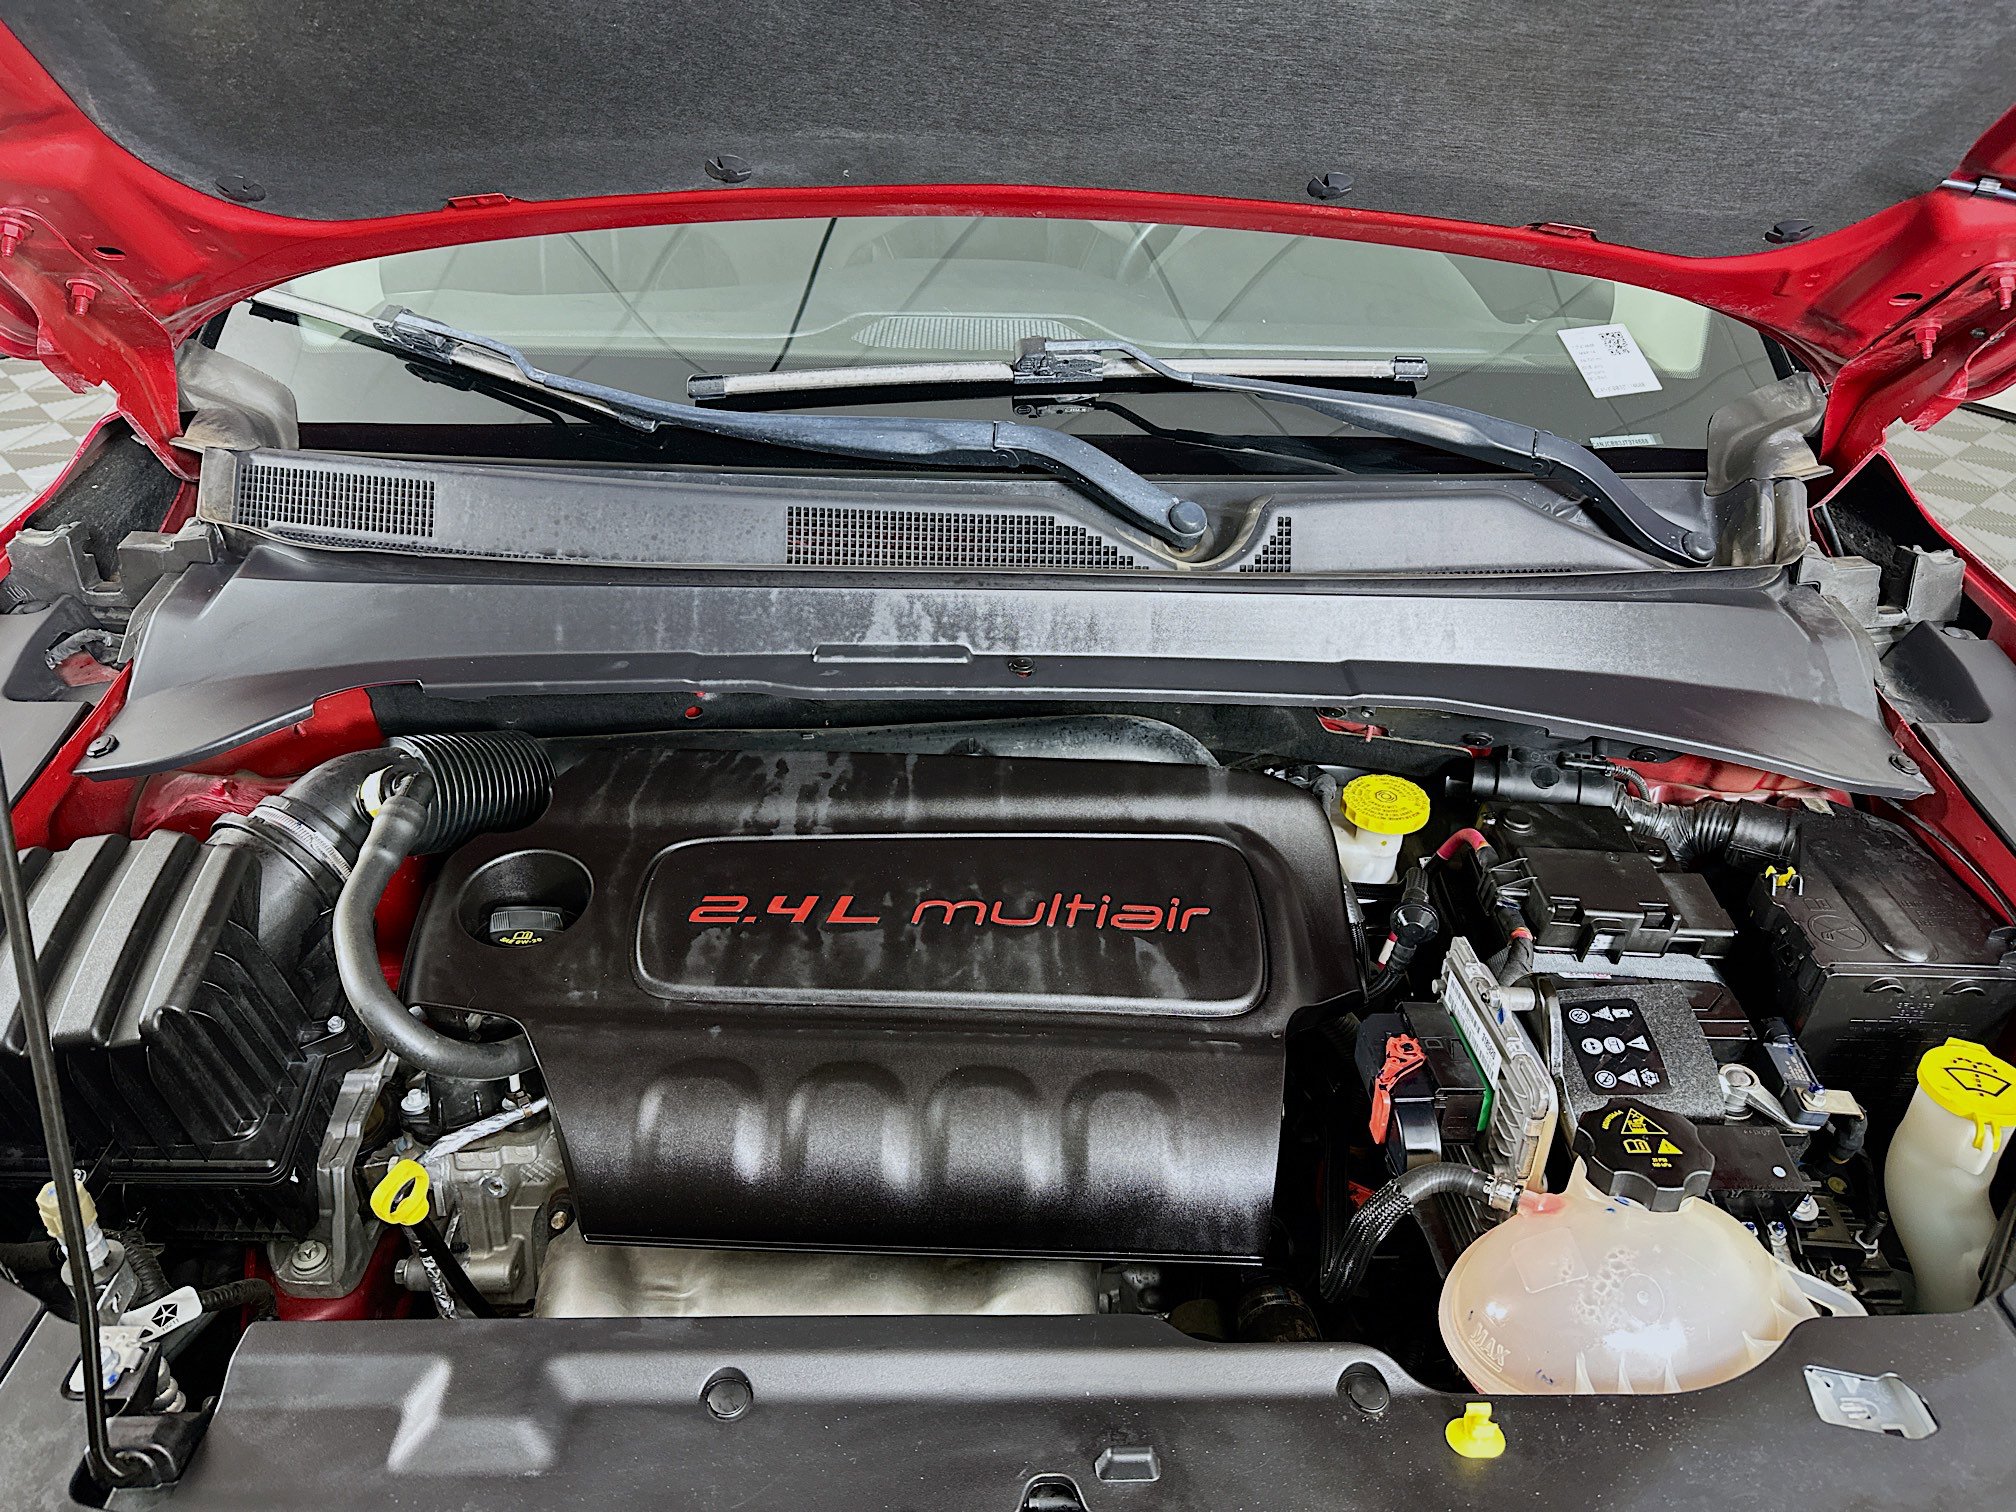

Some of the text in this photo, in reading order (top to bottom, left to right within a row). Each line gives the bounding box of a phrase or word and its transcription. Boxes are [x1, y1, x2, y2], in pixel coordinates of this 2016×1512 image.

[688, 892, 1211, 933] 2.4L multiair
[1470, 1322, 1511, 1367] MAX
